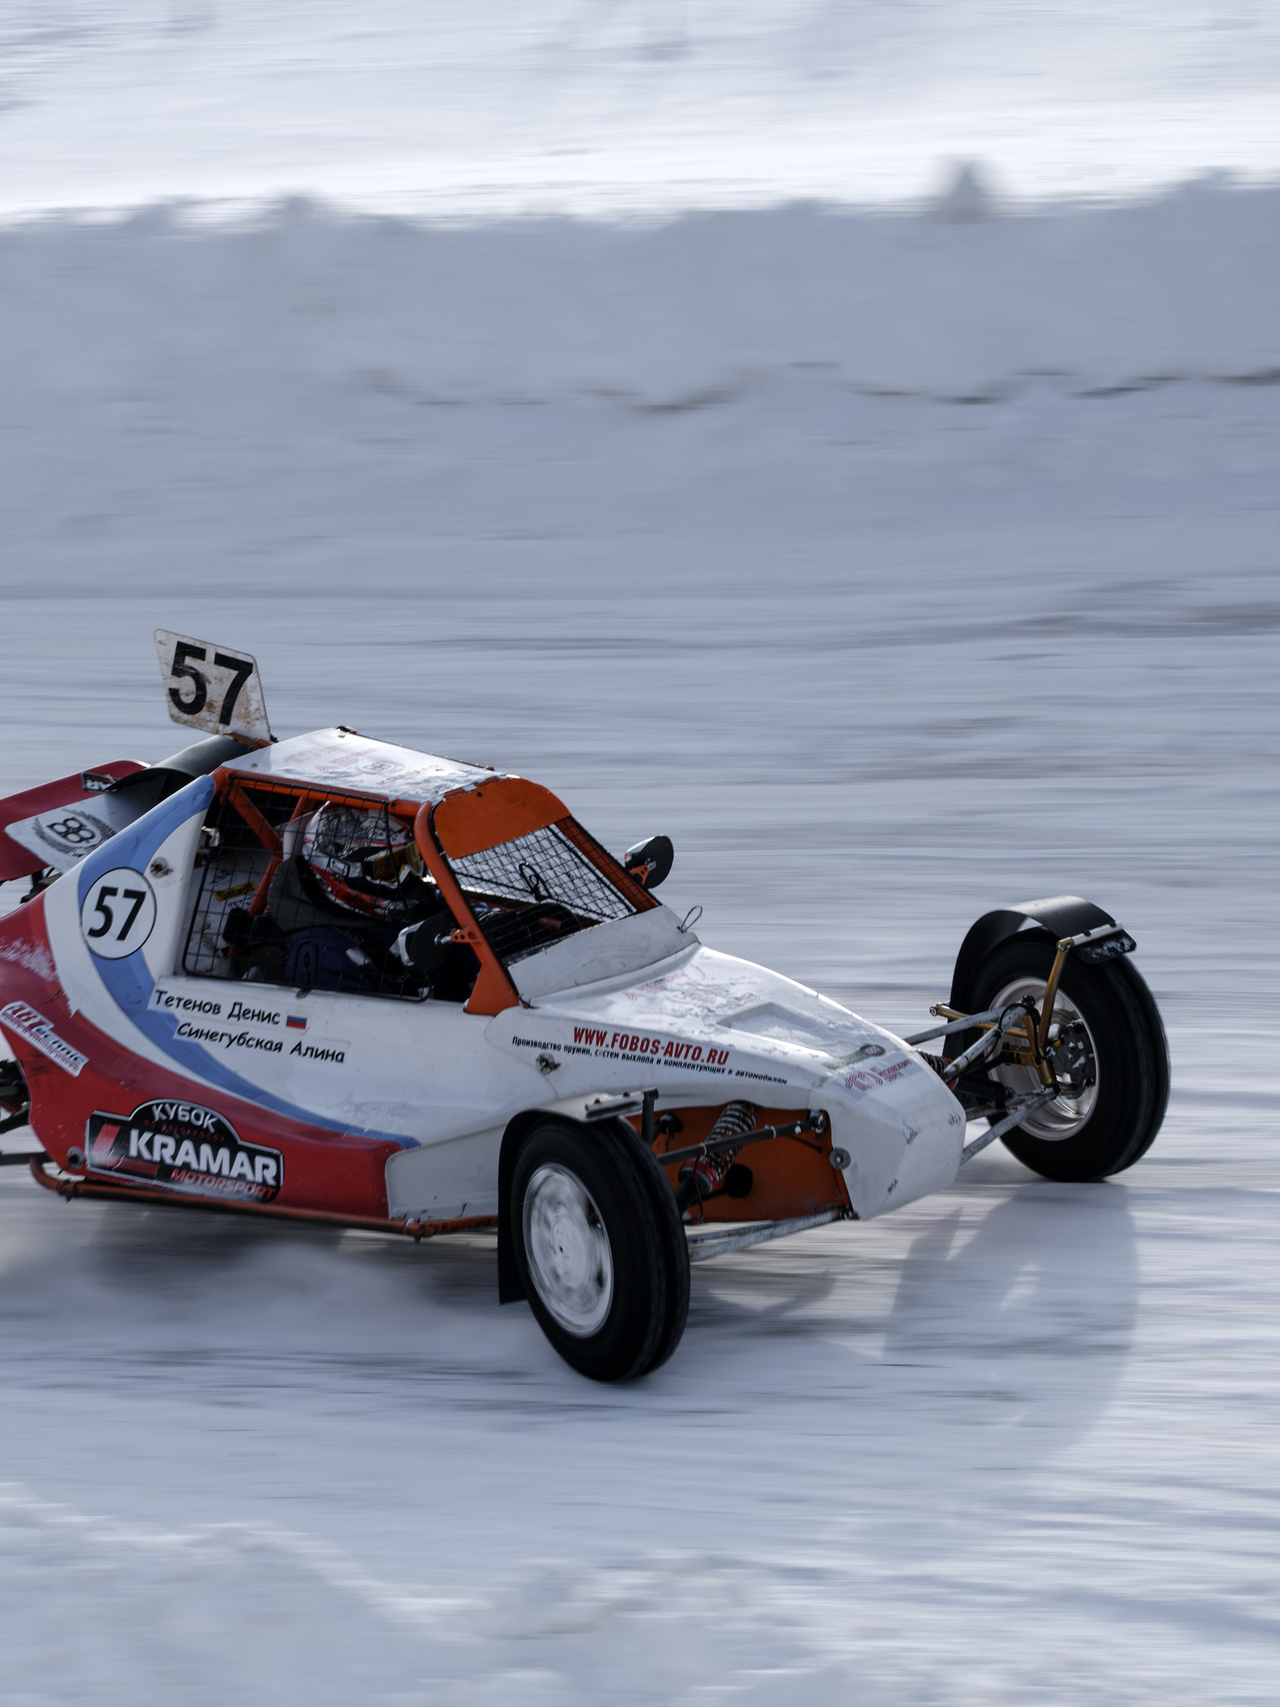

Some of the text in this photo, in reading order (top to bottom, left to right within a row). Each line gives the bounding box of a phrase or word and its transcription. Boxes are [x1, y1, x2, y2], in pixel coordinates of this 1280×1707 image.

[168, 640, 254, 726] 57
[87, 886, 147, 941] 57
[154, 989, 281, 1025] Тетенов Денис
[176, 1022, 346, 1064] Синегубская Алина
[512, 1035, 561, 1052] Производство
[563, 1044, 593, 1057] пружин,
[621, 1051, 654, 1065] выхлопа
[735, 1069, 787, 1085] автомобилям
[573, 1026, 729, 1066] WWW.FOBOS-AVTO.RU
[151, 1103, 219, 1134] КУБОК
[128, 1128, 278, 1187] KRAMAR
[170, 1168, 277, 1200] MOTORSPORT
